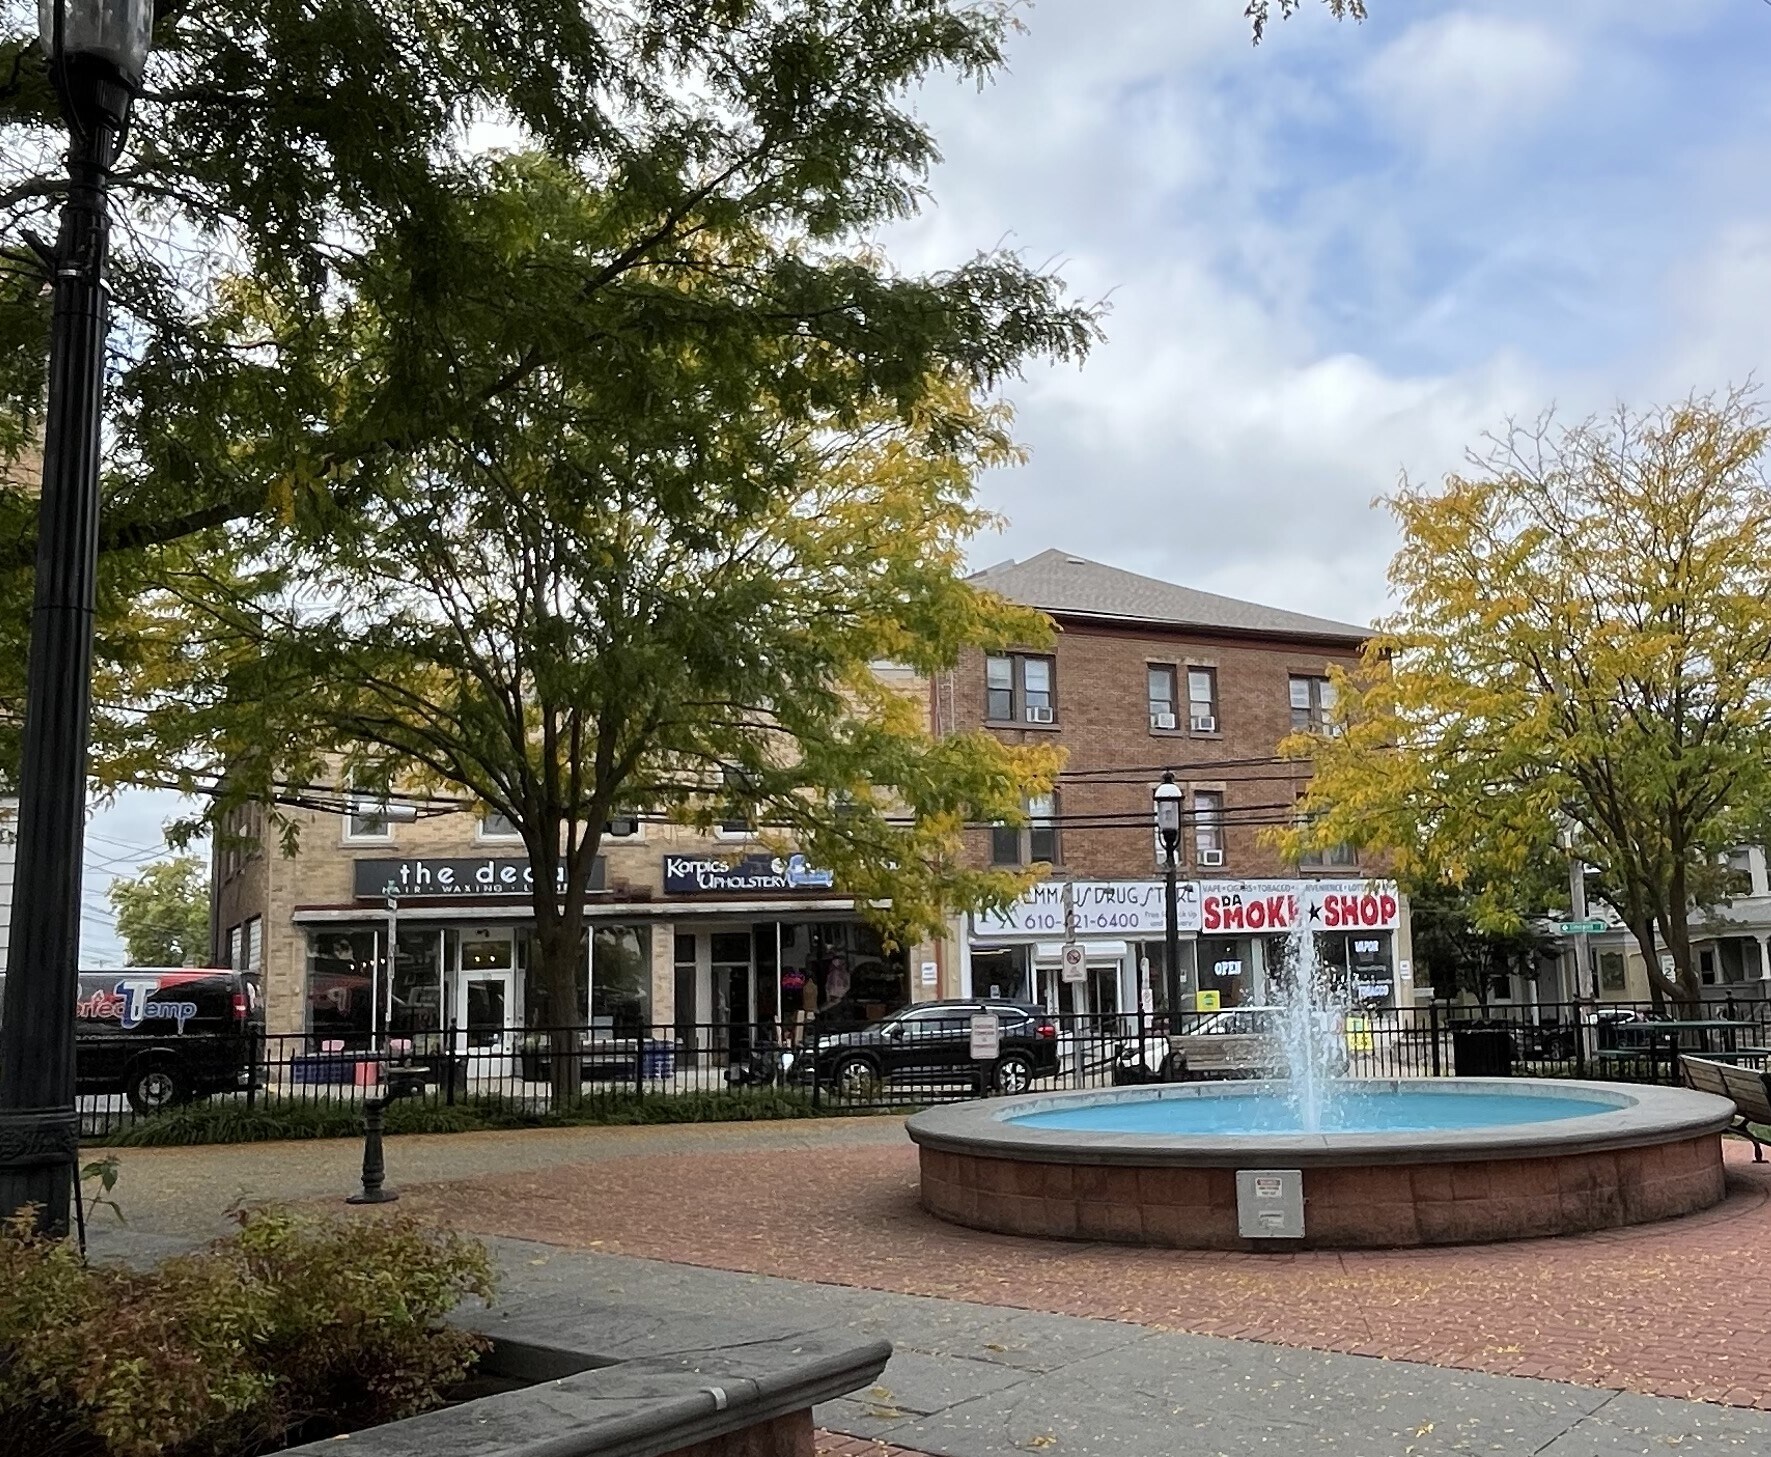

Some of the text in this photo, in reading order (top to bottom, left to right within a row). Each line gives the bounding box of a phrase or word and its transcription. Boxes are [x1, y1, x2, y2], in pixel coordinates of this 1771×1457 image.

[400, 861, 455, 884] the
[667, 858, 729, 882] Korpics
[442, 884, 502, 893] WAXING
[1095, 887, 1138, 904] DRUG
[1140, 886, 1197, 907] STRE
[1202, 884, 1221, 893] VAPE
[1257, 884, 1291, 892] TOBACCO
[1222, 894, 1242, 907] DA
[1324, 895, 1396, 926] SHOP
[1025, 913, 1139, 930] 610-21-6400
[1214, 960, 1242, 976] OPEN
